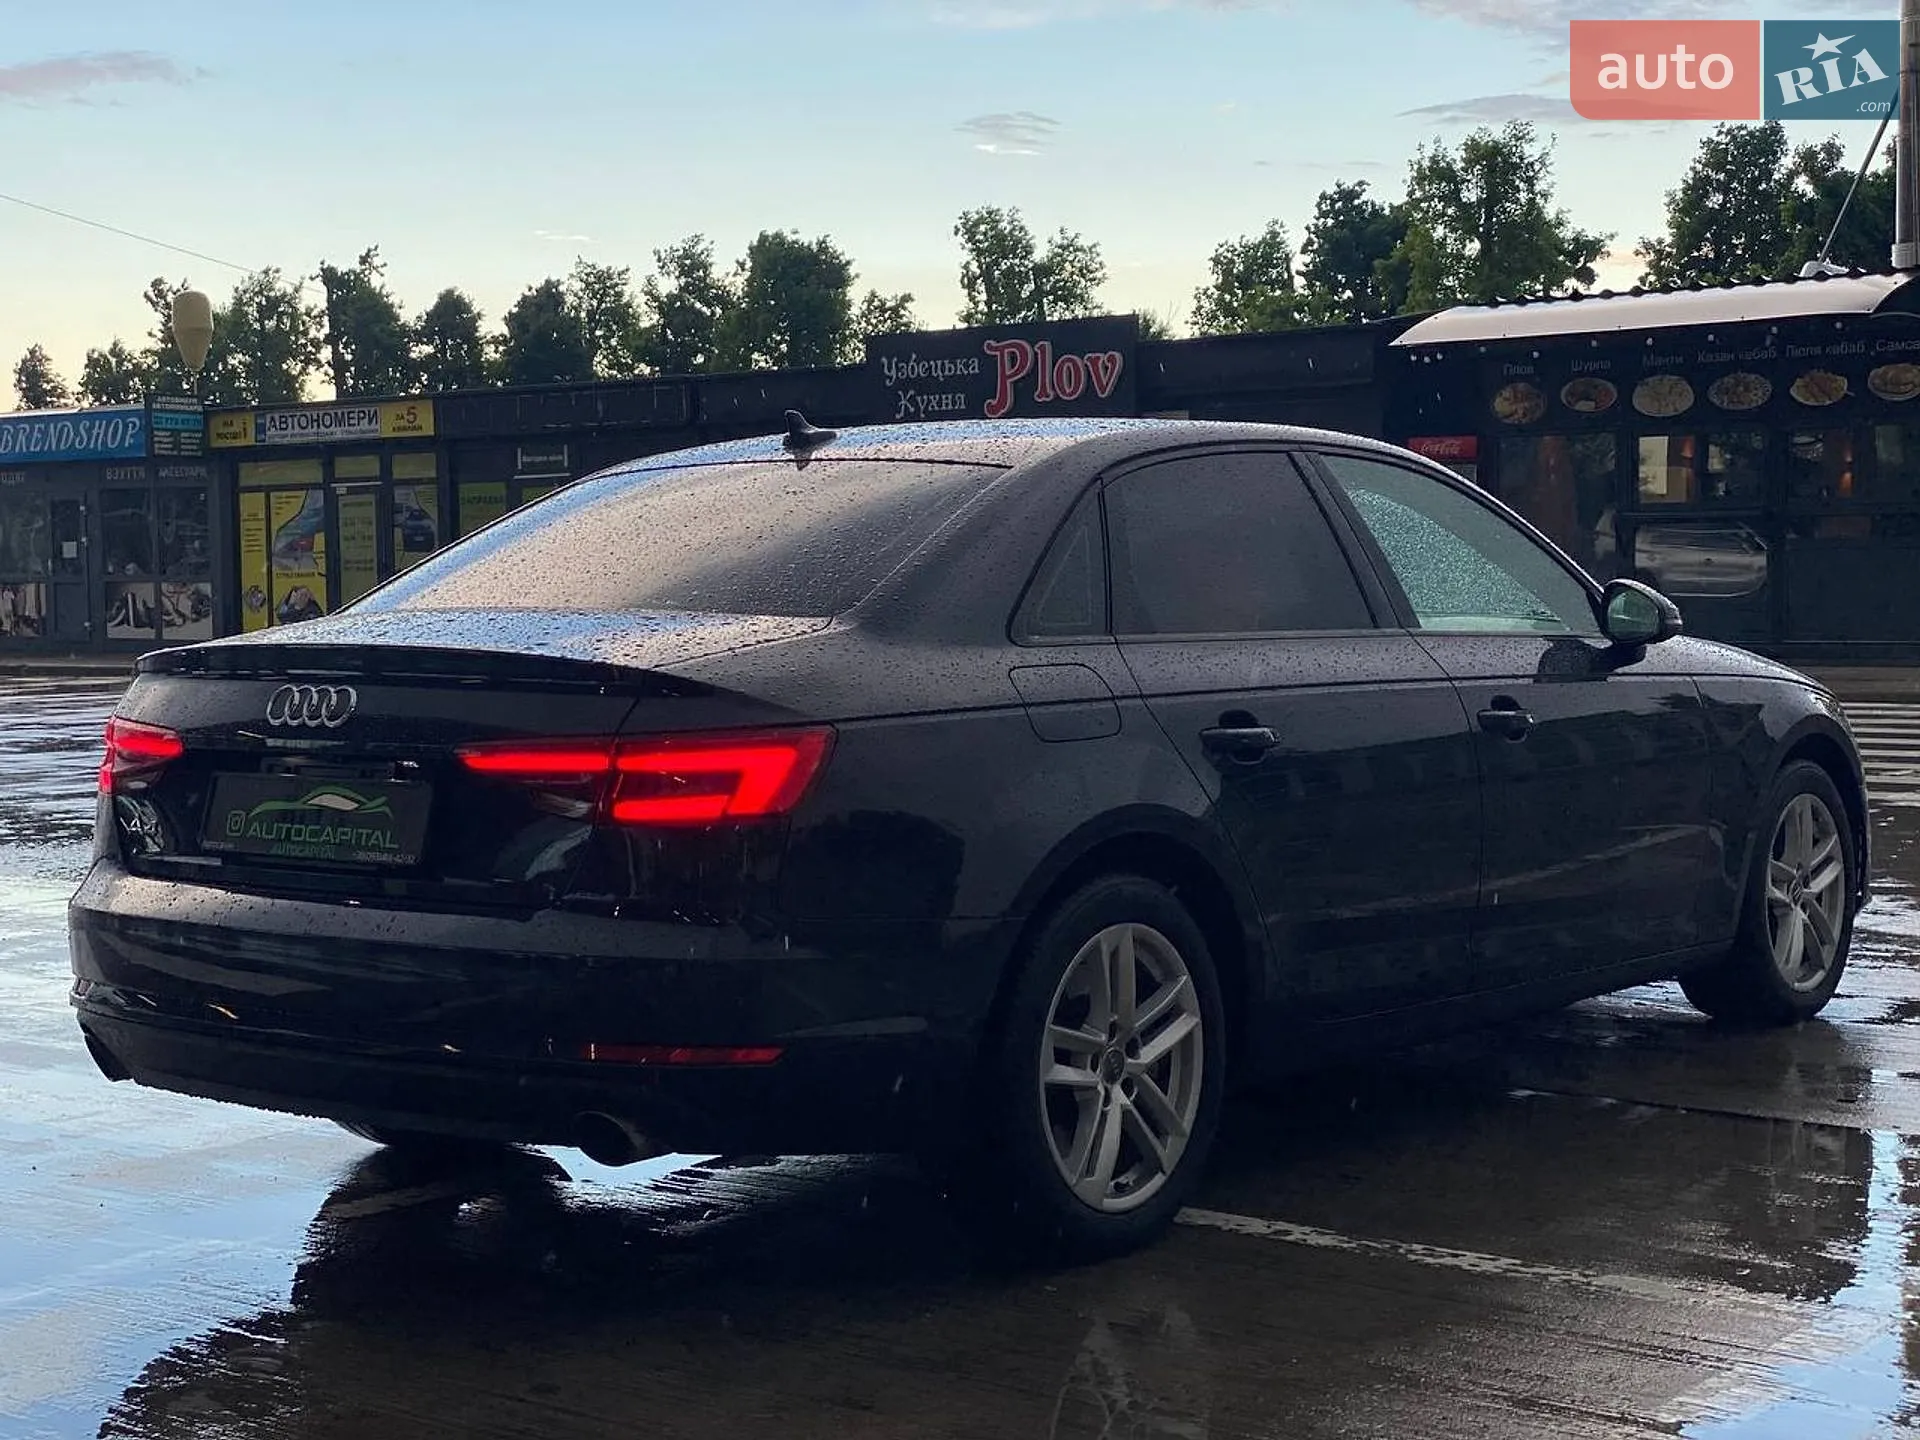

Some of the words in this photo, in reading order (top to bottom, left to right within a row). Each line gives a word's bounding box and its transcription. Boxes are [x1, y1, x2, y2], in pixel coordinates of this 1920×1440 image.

[881, 353, 980, 387] Узбецька
[984, 338, 1122, 418] Plov
[406, 405, 418, 425] 5
[895, 391, 967, 419] Кухня
[267, 408, 378, 433] АВТОНОМЕРИ
[0, 418, 140, 454] BRENDSHOP
[246, 822, 400, 849] AUTOCAPITAL
